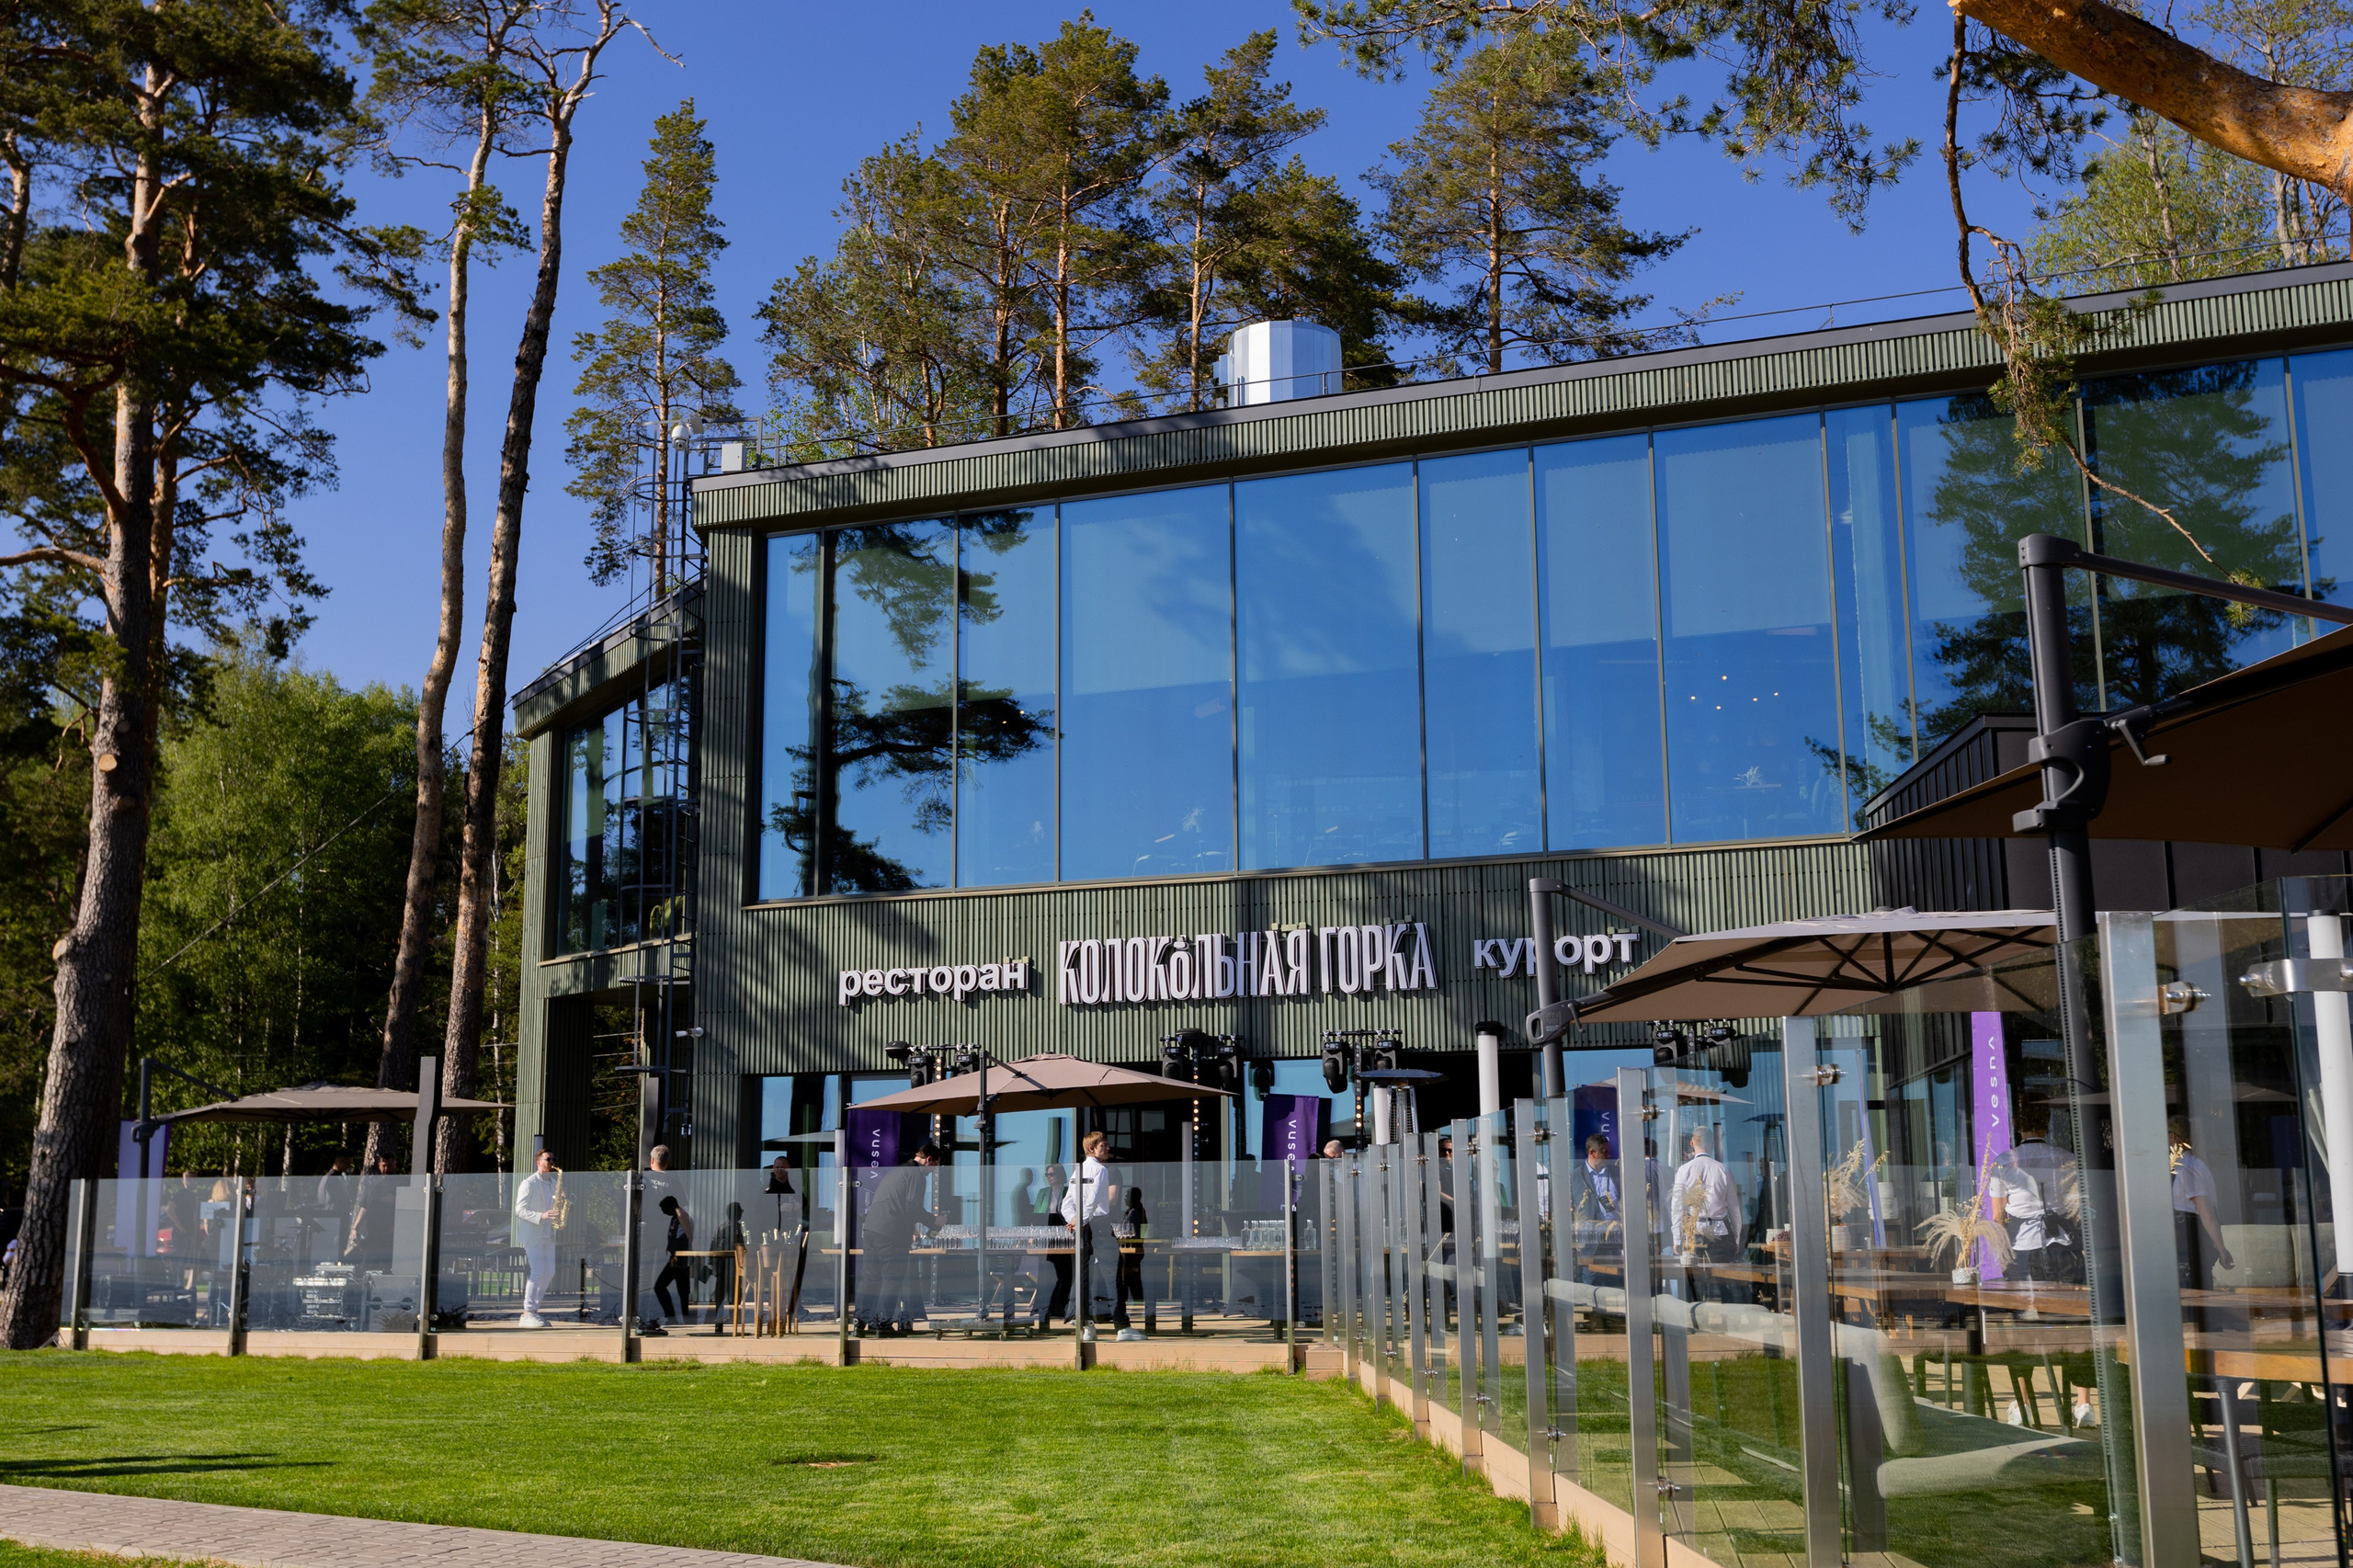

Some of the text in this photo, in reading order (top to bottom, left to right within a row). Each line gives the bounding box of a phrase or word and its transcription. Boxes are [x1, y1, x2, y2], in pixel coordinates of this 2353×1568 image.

[839, 962, 1029, 1006] ресторан
[1059, 928, 1312, 1006] КОЛОКОЛЬНАЯ
[1320, 921, 1439, 994] ГОРКА
